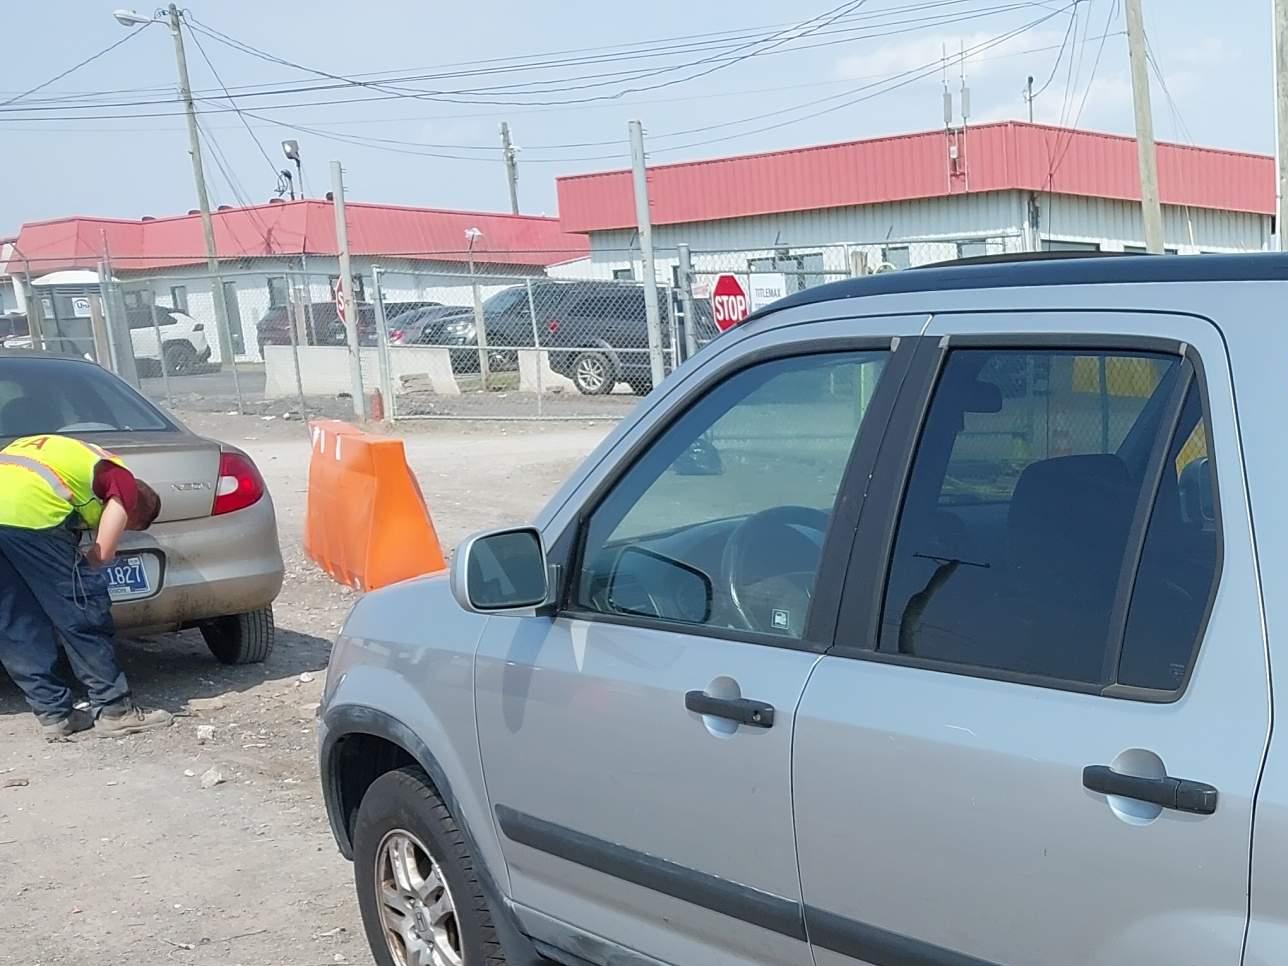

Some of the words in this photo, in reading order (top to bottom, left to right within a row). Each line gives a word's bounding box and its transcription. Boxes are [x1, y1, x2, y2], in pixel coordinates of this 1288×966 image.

[754, 287, 781, 298] TITLEMAX
[715, 295, 746, 321] STOP
[106, 565, 142, 585] 1827
